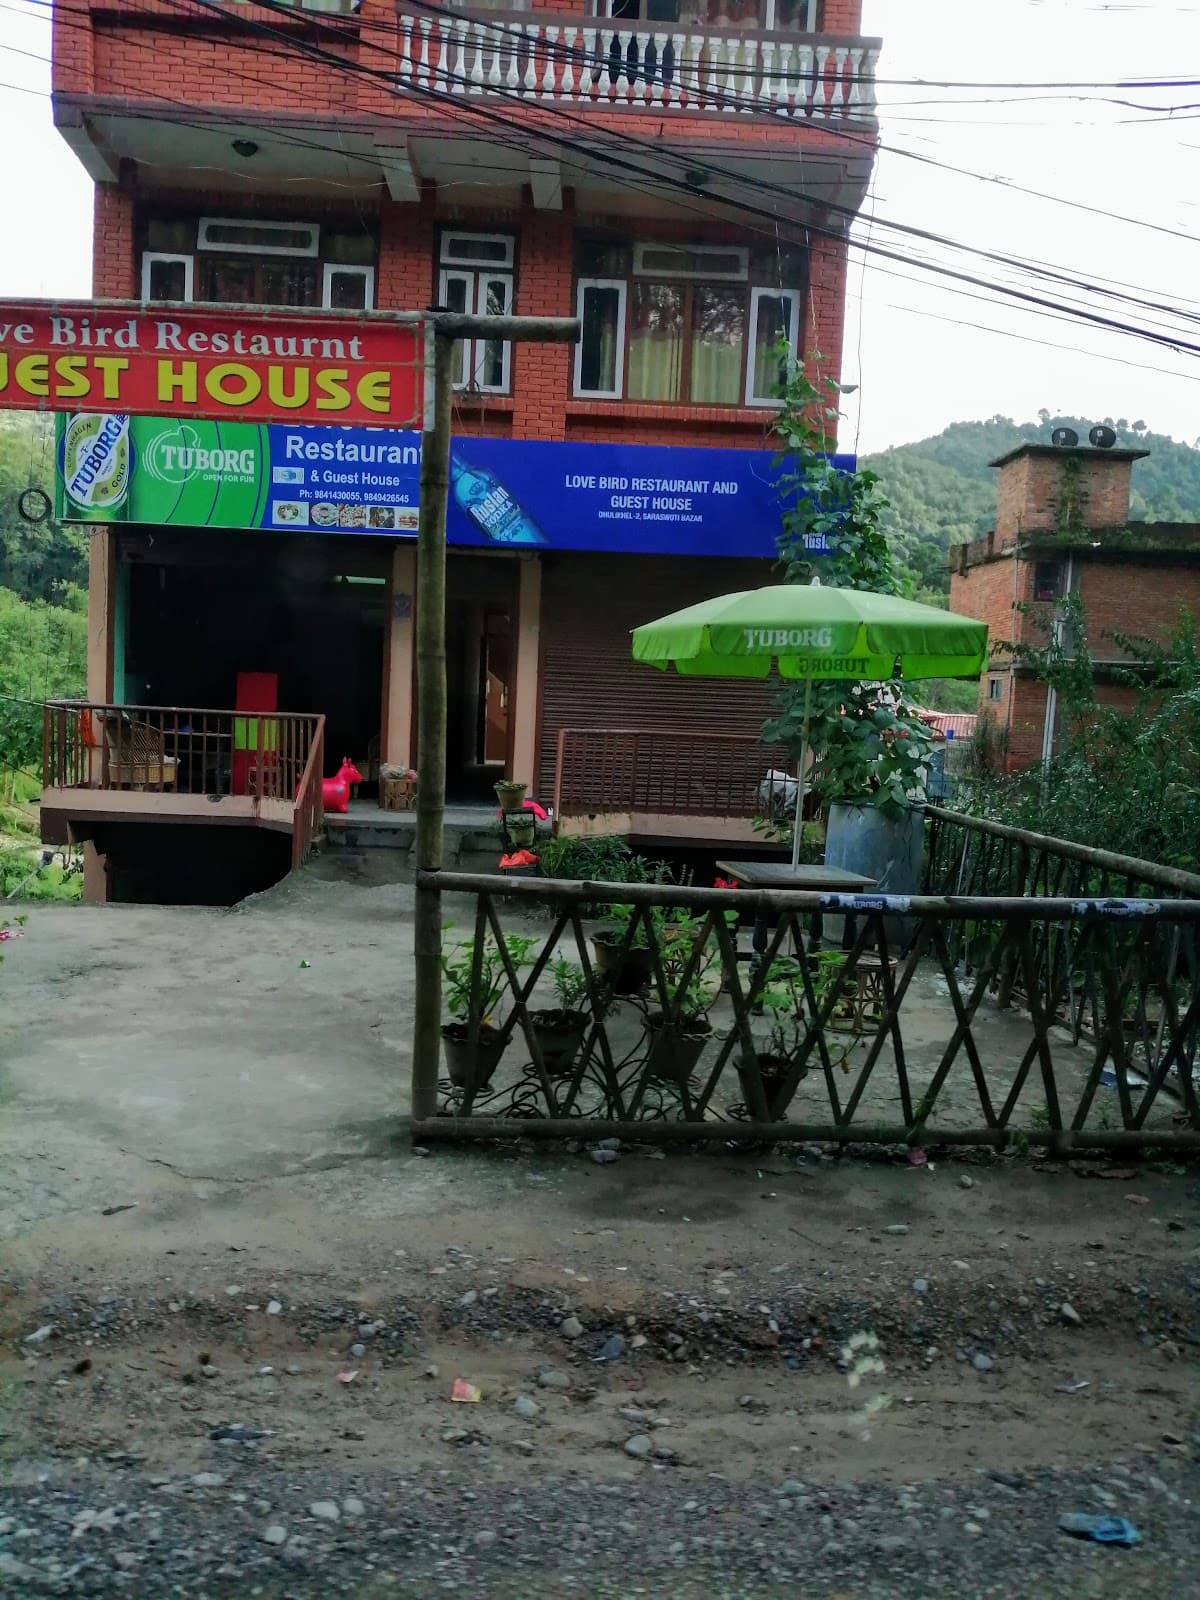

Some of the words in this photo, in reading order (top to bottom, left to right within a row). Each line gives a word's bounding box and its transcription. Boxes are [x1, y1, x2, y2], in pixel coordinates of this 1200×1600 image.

[0, 320, 34, 345] ve
[49, 316, 140, 349] Bird
[154, 321, 365, 360] Restaurnt
[0, 352, 129, 399] EST
[157, 359, 392, 413] HOUSE
[70, 417, 123, 497] TUBORG
[161, 444, 255, 475] TUBORG
[285, 434, 422, 465] Restauran
[111, 463, 127, 488] GOLD
[202, 473, 223, 482] OPEN
[224, 474, 239, 483] FOR
[239, 475, 255, 484] FUN
[310, 469, 320, 483] &
[323, 469, 359, 485] Guest
[361, 472, 400, 487] House
[565, 474, 596, 489] LOVE
[598, 476, 628, 490] BIRD
[631, 477, 709, 494] RESTAURANT
[711, 481, 738, 495] AND
[299, 489, 313, 499] Ph:
[610, 495, 649, 509] GUEST
[652, 496, 692, 511] HOUSE
[744, 628, 832, 650] TUBORG
